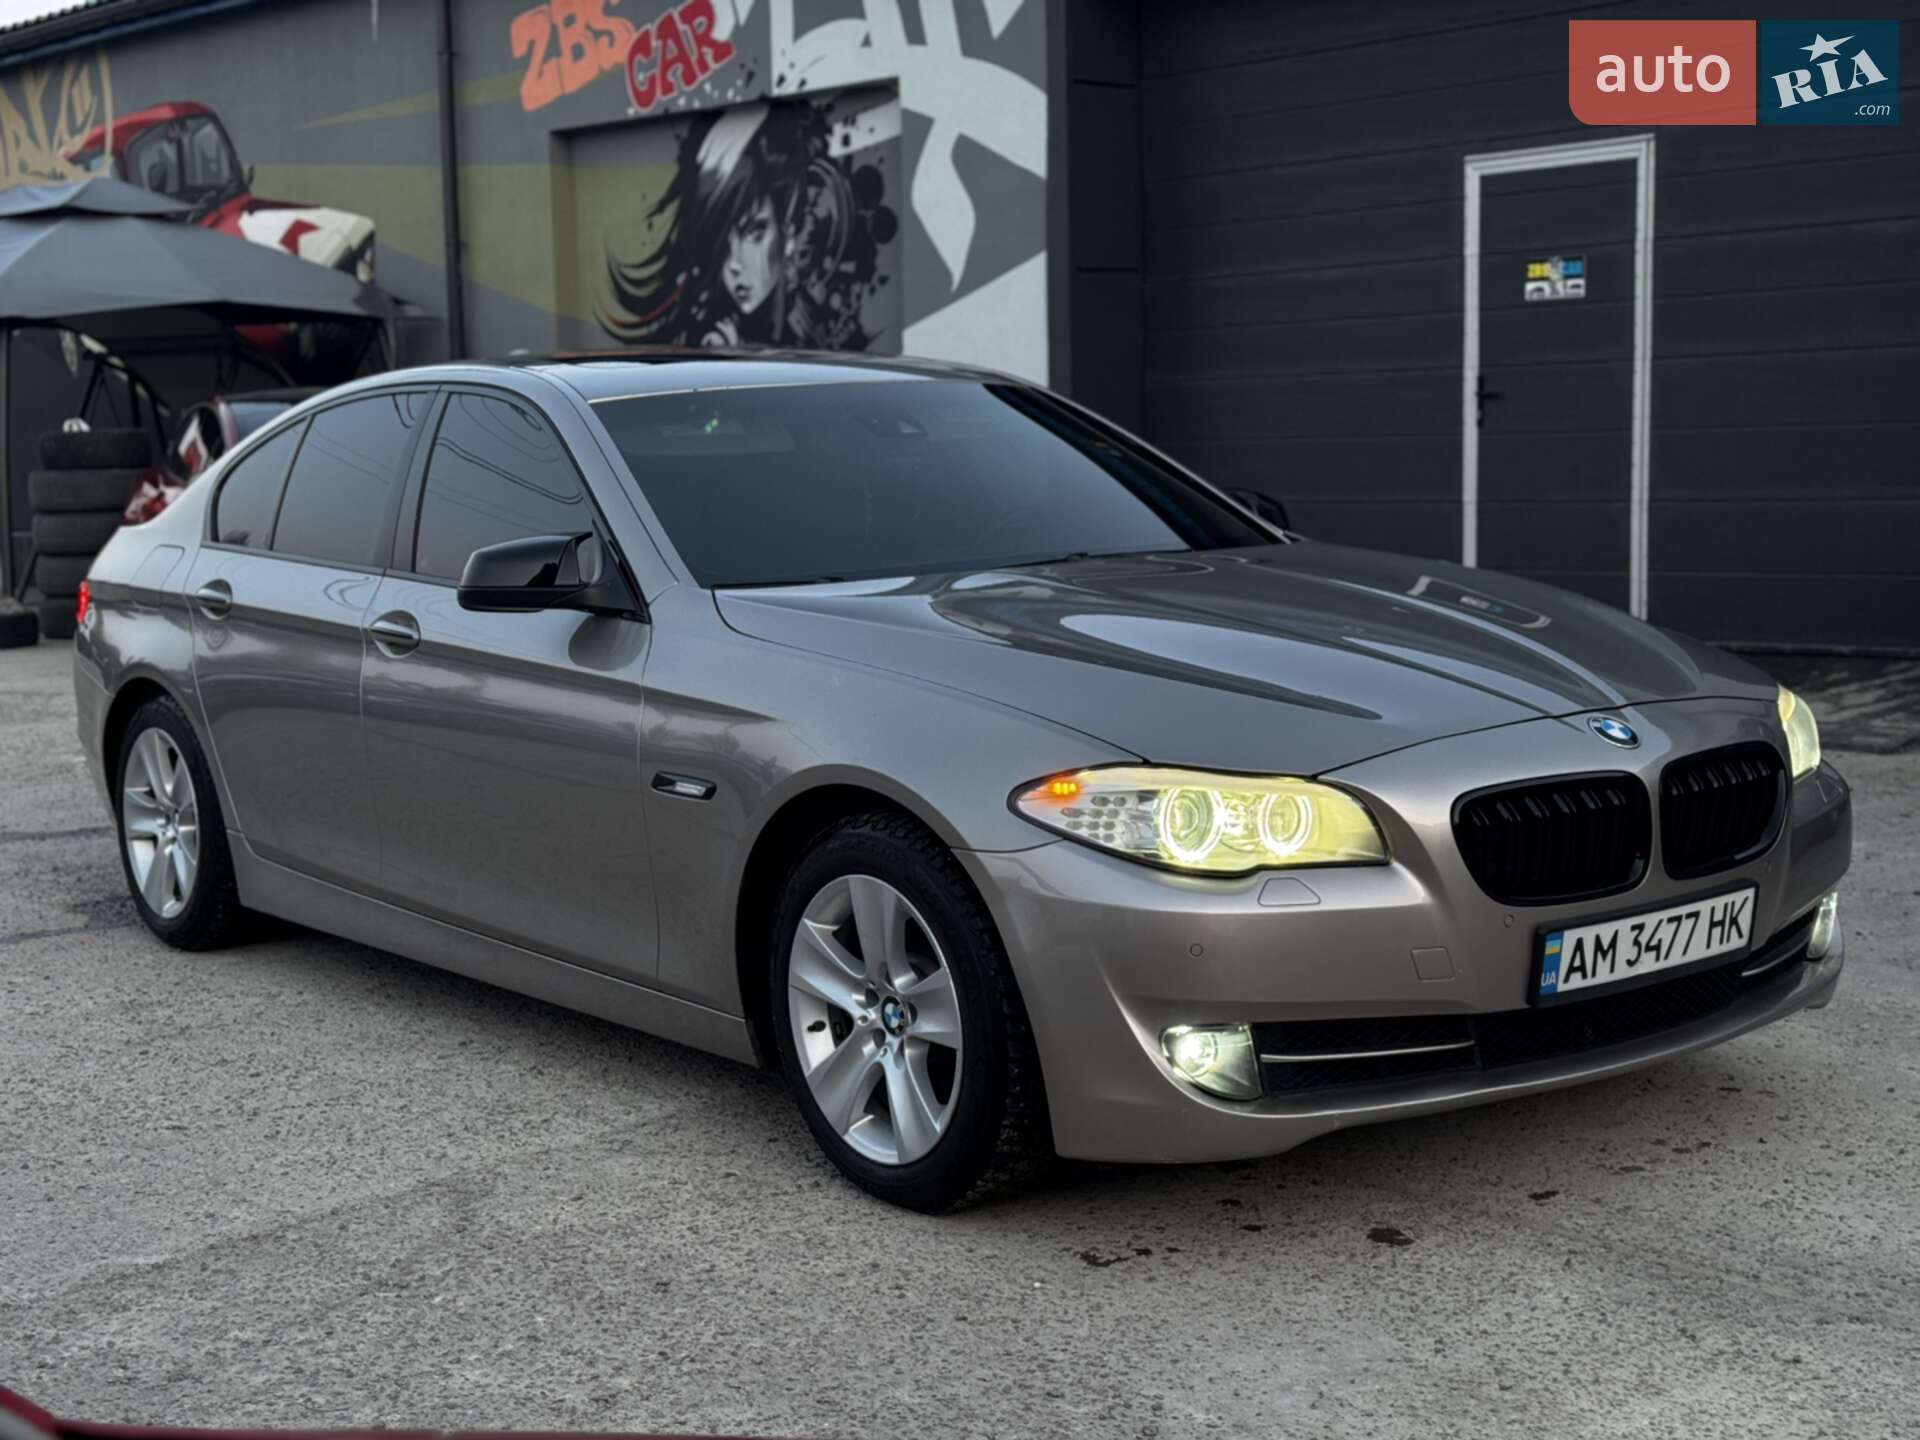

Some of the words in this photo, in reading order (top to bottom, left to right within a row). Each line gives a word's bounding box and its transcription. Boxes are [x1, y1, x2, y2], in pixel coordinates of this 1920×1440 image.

[625, 0, 736, 111] CAR
[1541, 970, 1557, 987] UA
[1562, 929, 1619, 984] AM
[1625, 910, 1701, 968] 3477
[1706, 896, 1749, 950] HK
